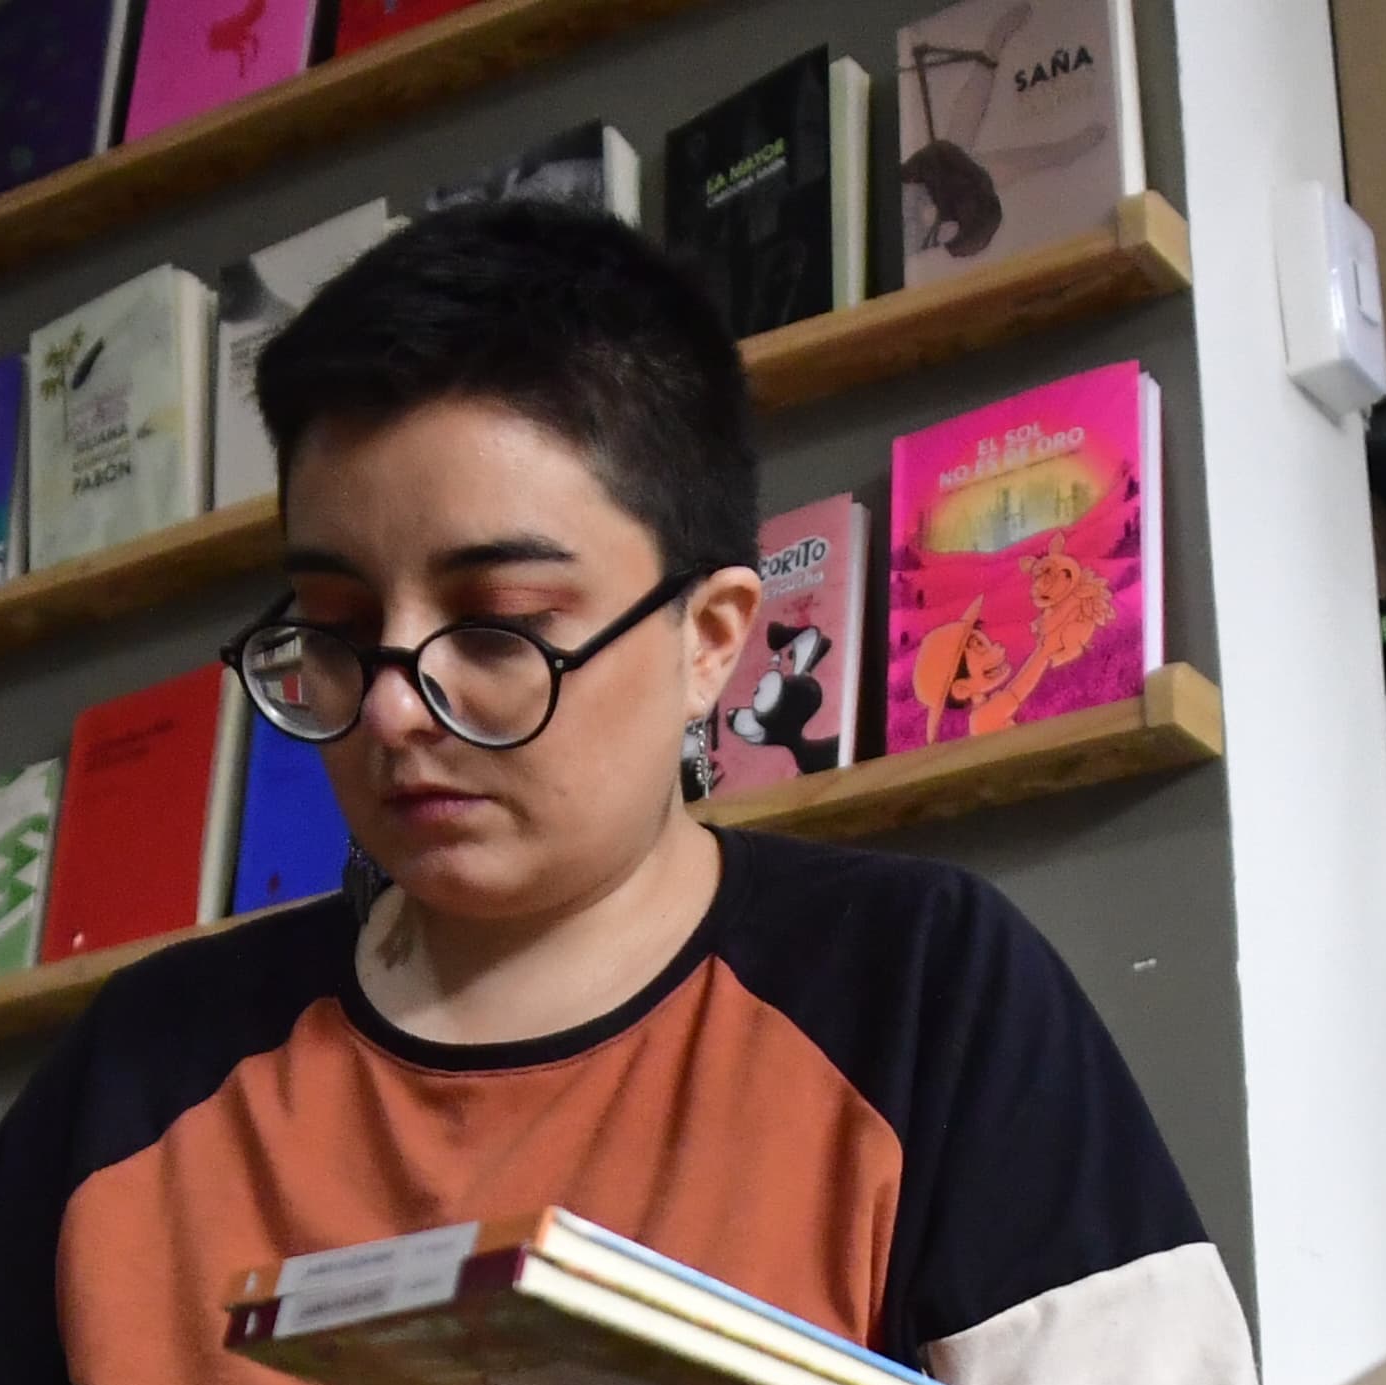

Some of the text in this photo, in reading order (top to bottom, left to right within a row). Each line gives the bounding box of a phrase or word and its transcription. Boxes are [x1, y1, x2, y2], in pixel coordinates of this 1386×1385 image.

[1015, 45, 1093, 92] SAÑA
[939, 465, 969, 488] NO
[1037, 426, 1084, 452] ORO
[978, 422, 1040, 456] EL SOL
[758, 537, 826, 581] CORITO
